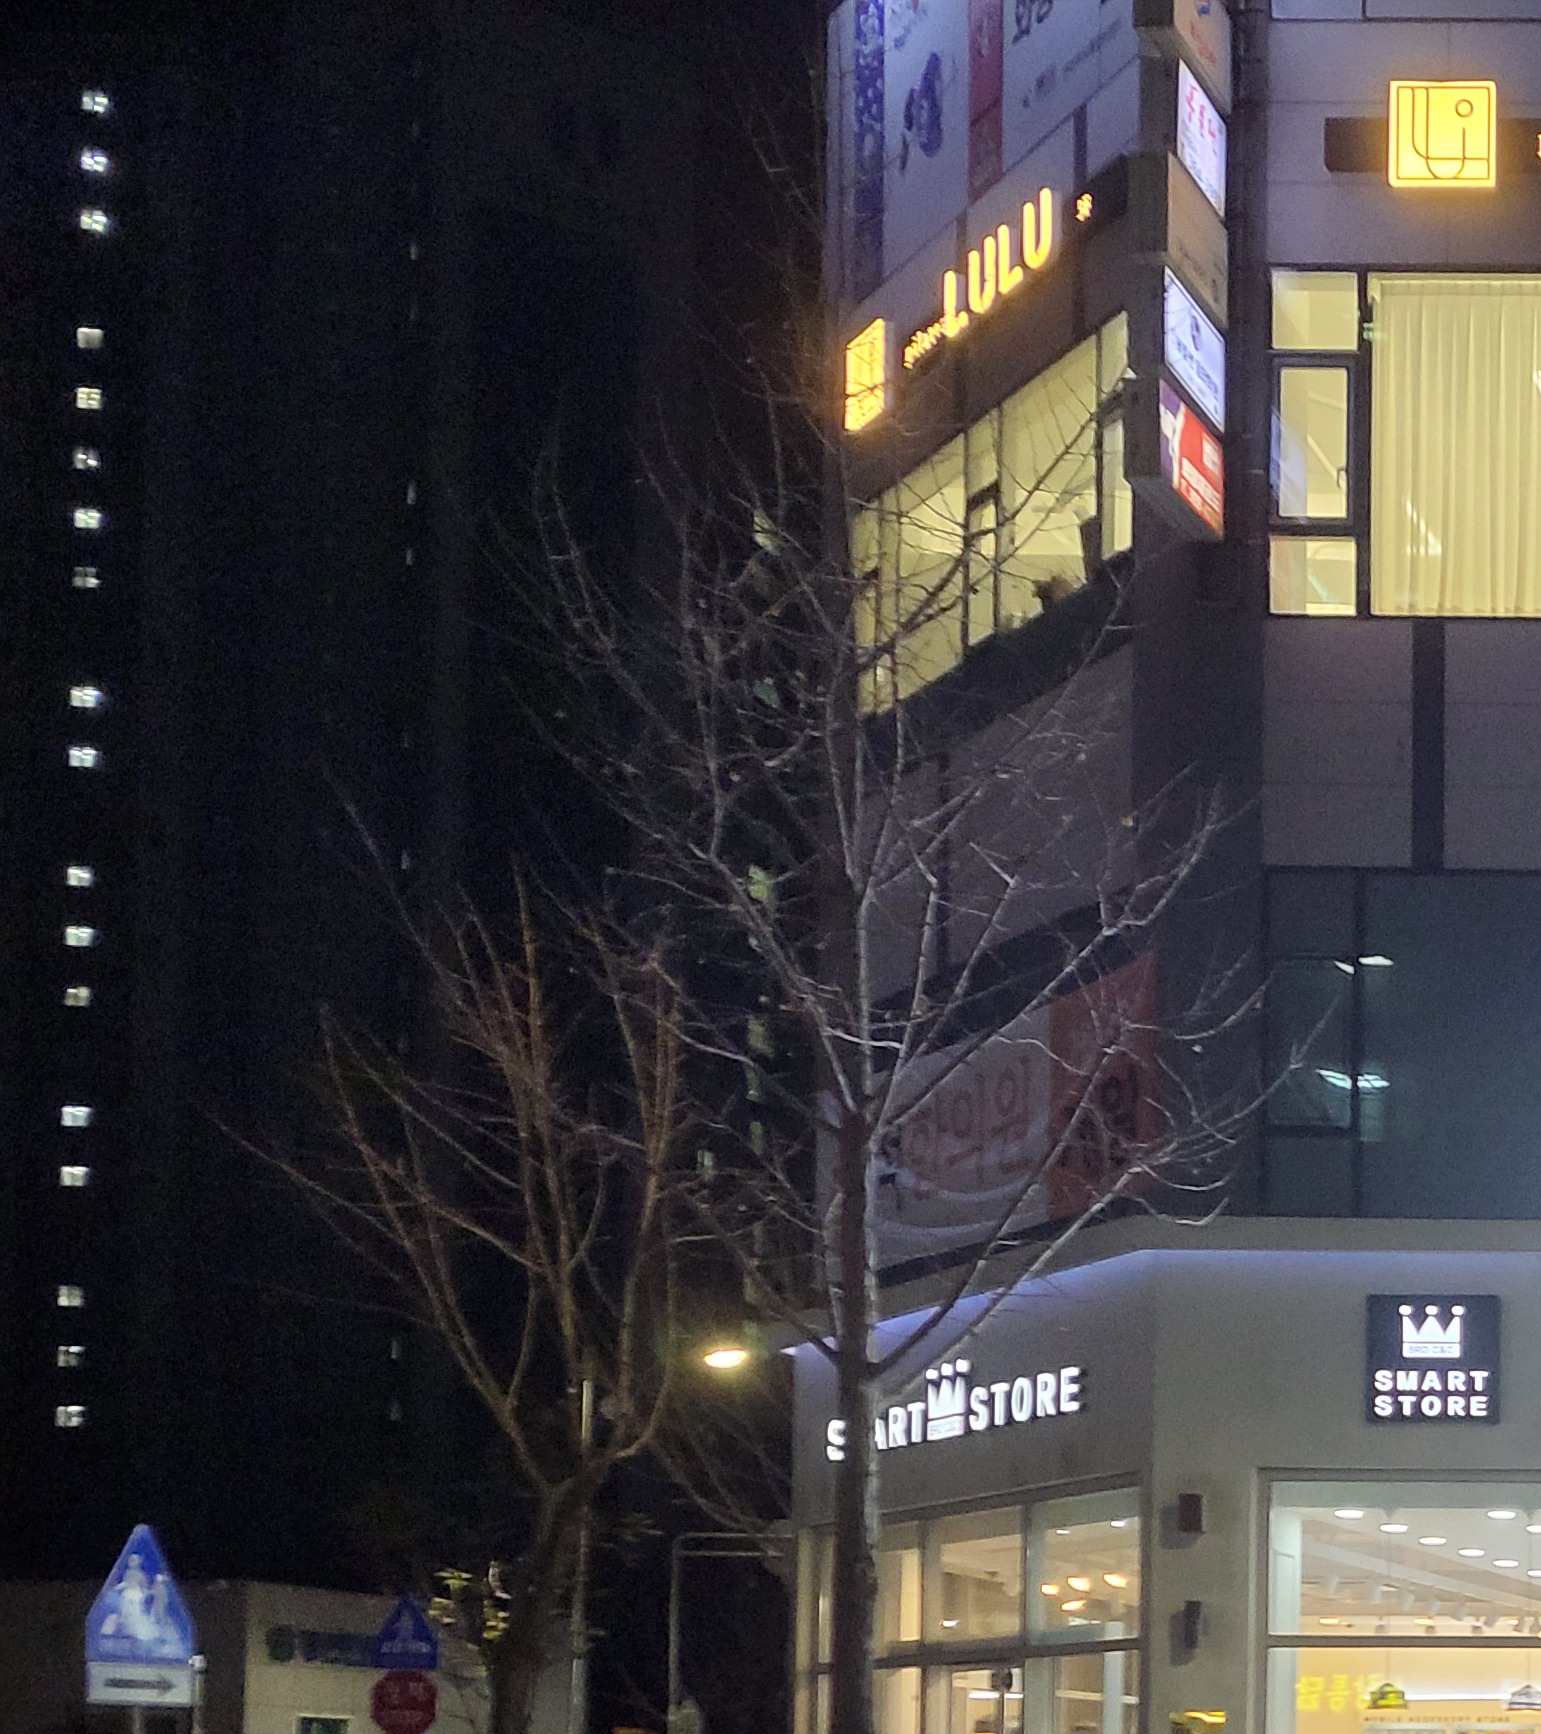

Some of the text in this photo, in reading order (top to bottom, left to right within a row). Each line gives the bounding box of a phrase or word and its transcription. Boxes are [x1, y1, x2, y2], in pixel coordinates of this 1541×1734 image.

[943, 187, 1053, 338] LULU
[1374, 1369, 1489, 1392] SMART
[1374, 1395, 1488, 1417] STORE
[826, 1366, 1082, 1462] SART STORE
